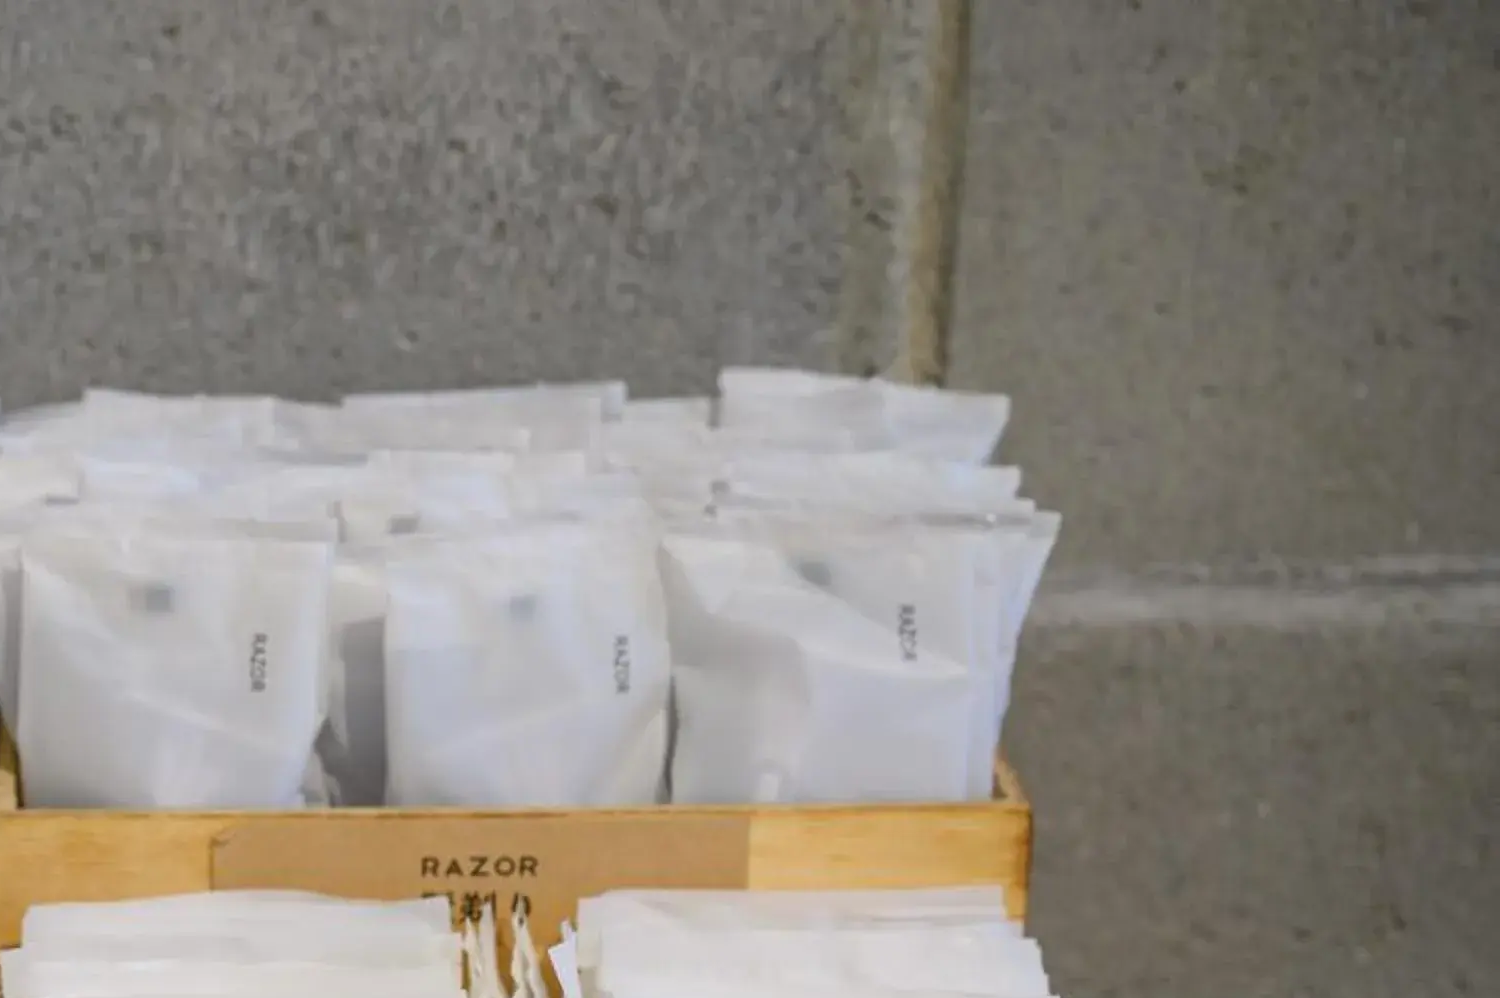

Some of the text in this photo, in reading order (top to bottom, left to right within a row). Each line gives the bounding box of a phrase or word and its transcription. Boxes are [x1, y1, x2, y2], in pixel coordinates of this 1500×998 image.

[898, 604, 917, 662] RAZOR
[249, 633, 268, 692] RAZOR
[613, 636, 631, 694] RAZOR
[420, 855, 538, 878] RAZOR
